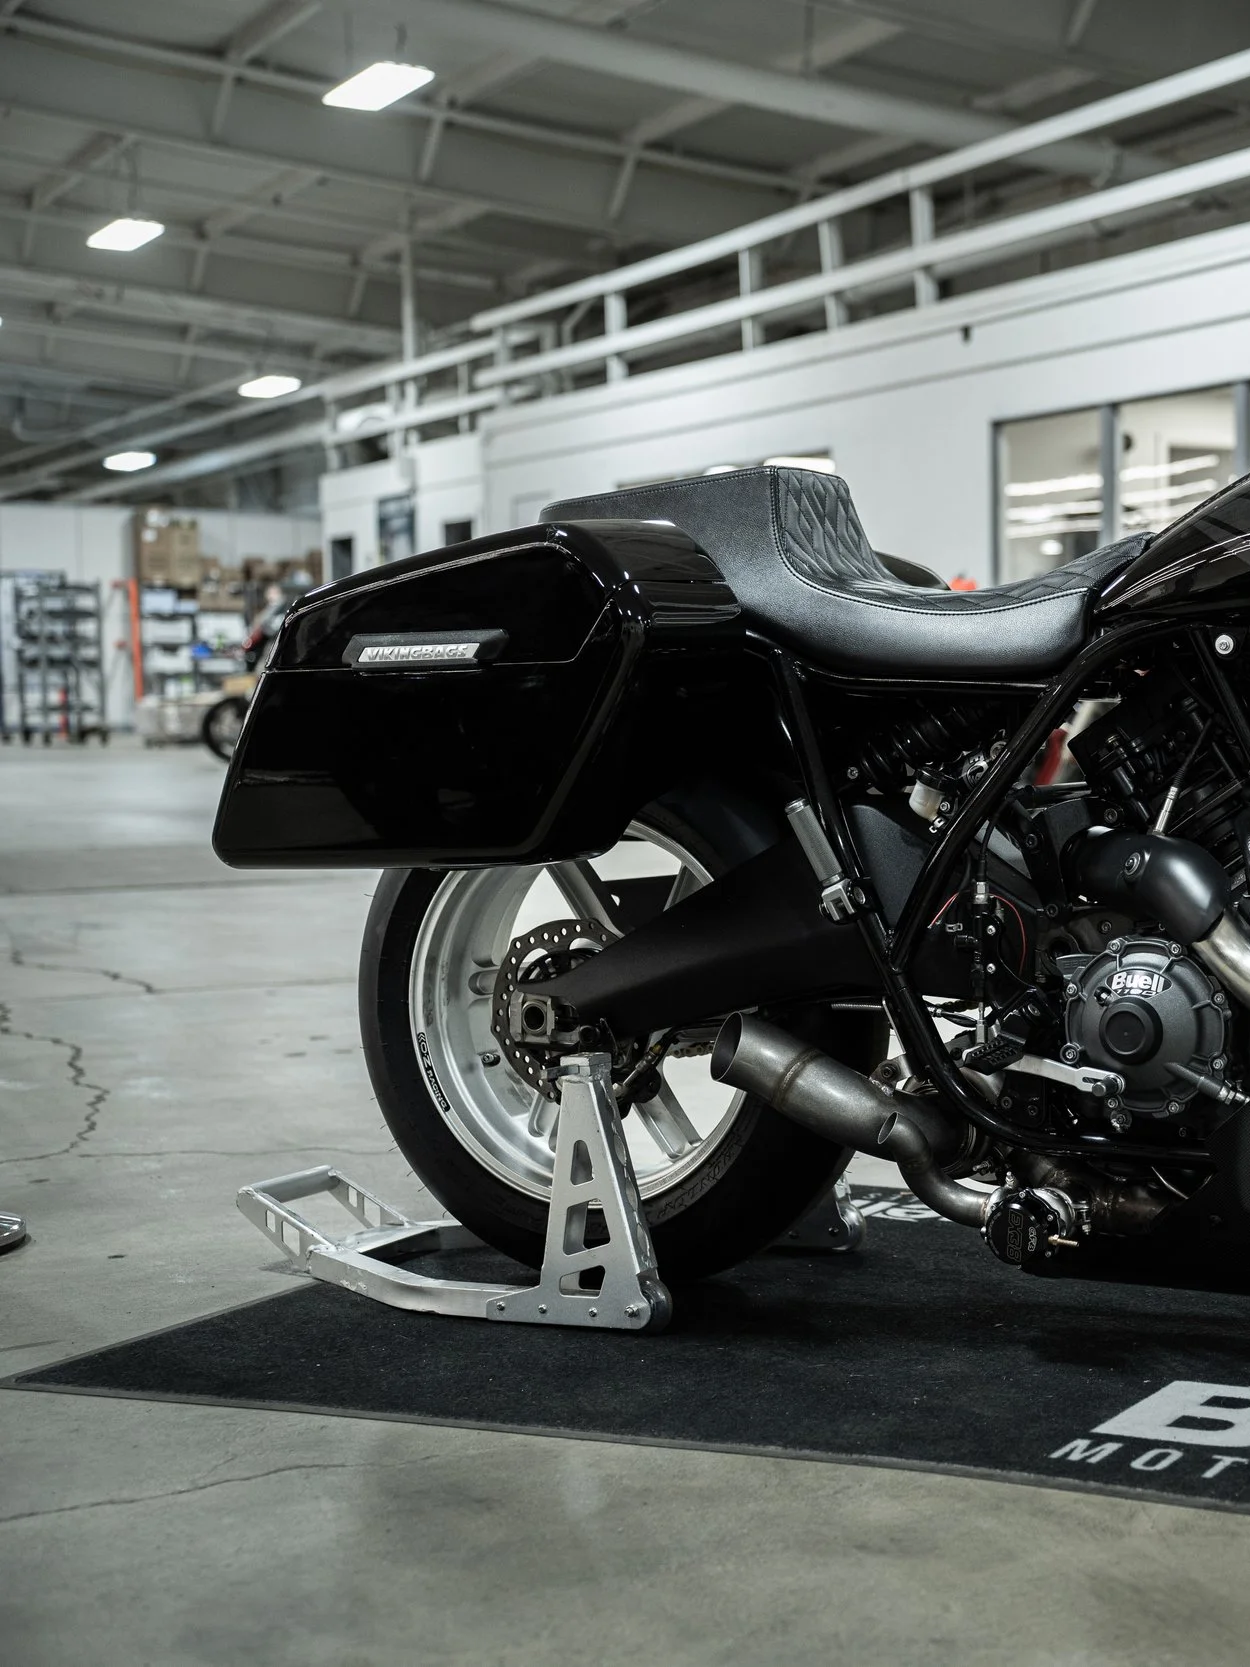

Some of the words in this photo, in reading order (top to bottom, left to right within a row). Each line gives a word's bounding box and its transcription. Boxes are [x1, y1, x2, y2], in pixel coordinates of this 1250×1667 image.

[367, 644, 468, 661] VIKINGBAGS
[1111, 971, 1165, 993] Buell
[426, 1069, 448, 1108] RACING
[1007, 1209, 1023, 1263] EX38
